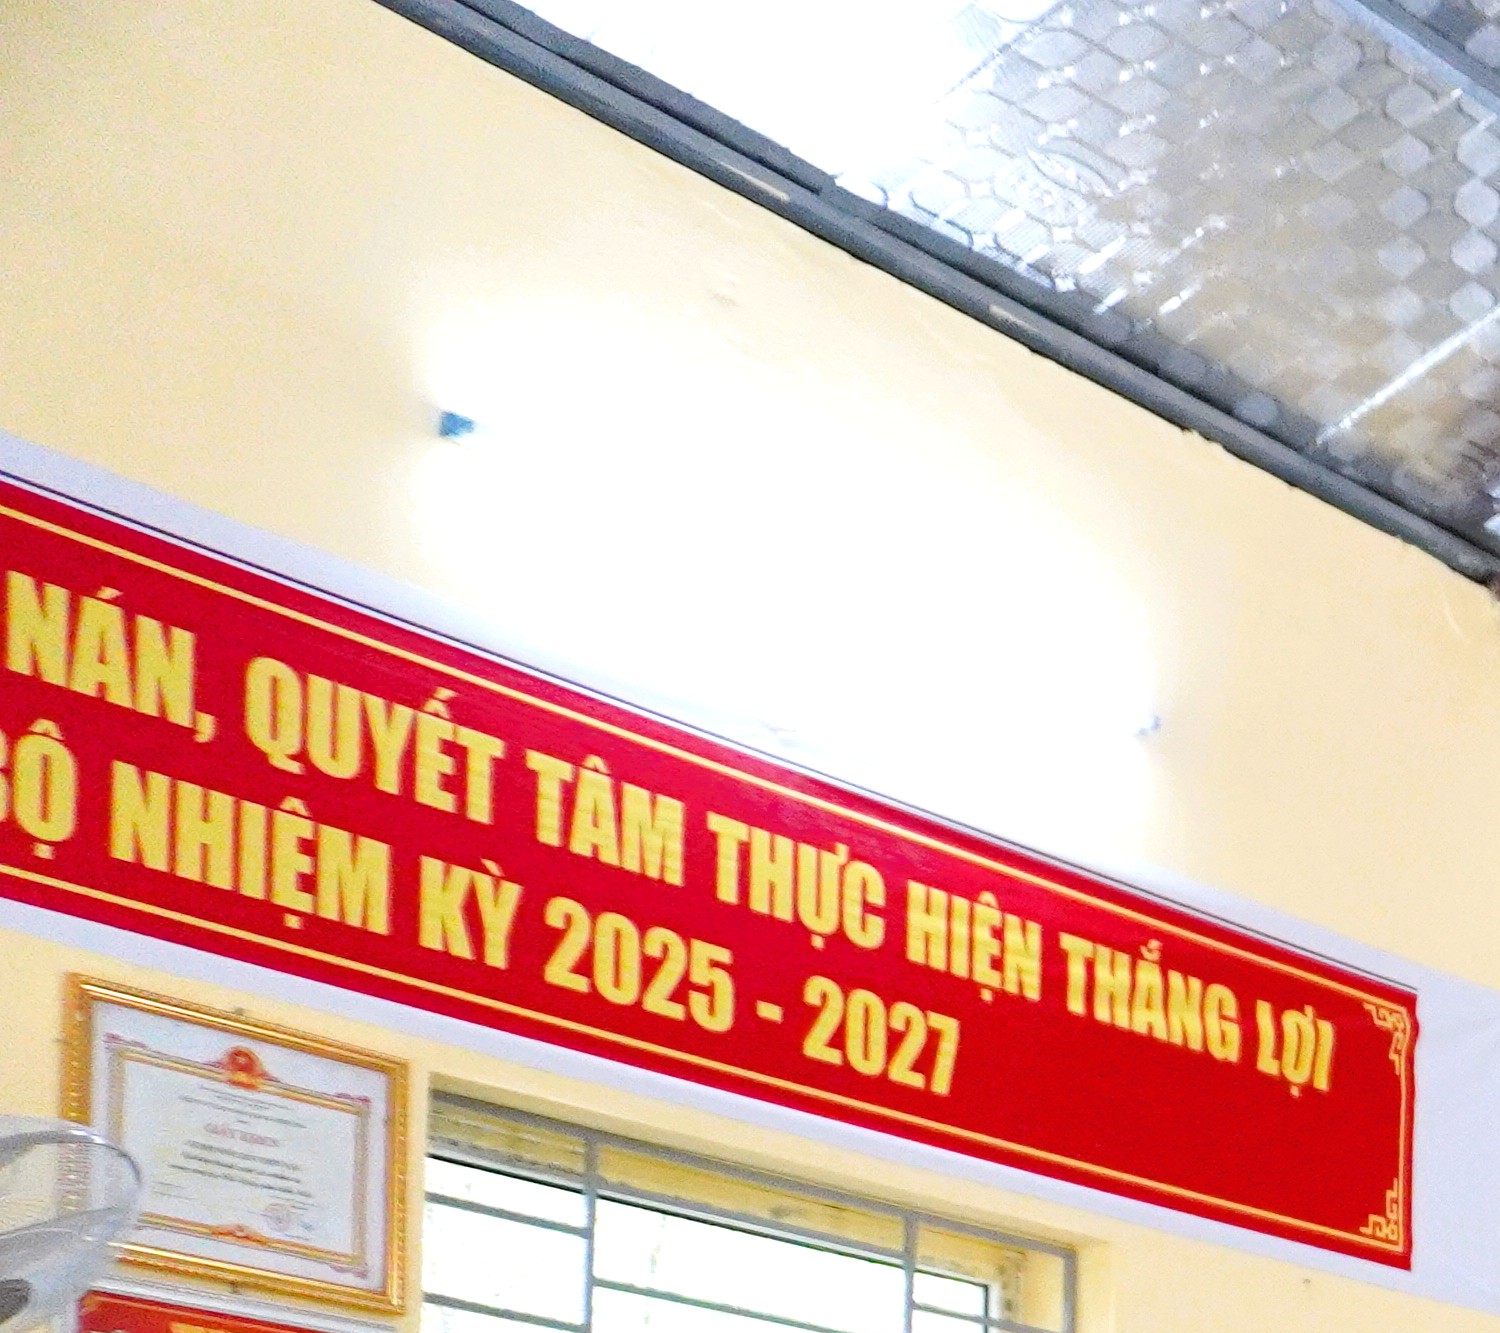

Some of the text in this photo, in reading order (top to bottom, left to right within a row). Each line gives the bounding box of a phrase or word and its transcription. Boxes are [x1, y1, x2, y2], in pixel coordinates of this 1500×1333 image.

[0, 717, 961, 1097] Ộ NHIỆM KỲ 2025 - 2027
[244, 656, 504, 825] QUYẾT
[525, 754, 687, 888] TÂM
[704, 809, 888, 950] THỰC
[905, 877, 1042, 1003] HIỆN
[1059, 931, 1242, 1065] THẮNG
[1256, 998, 1336, 1098] LỢI
